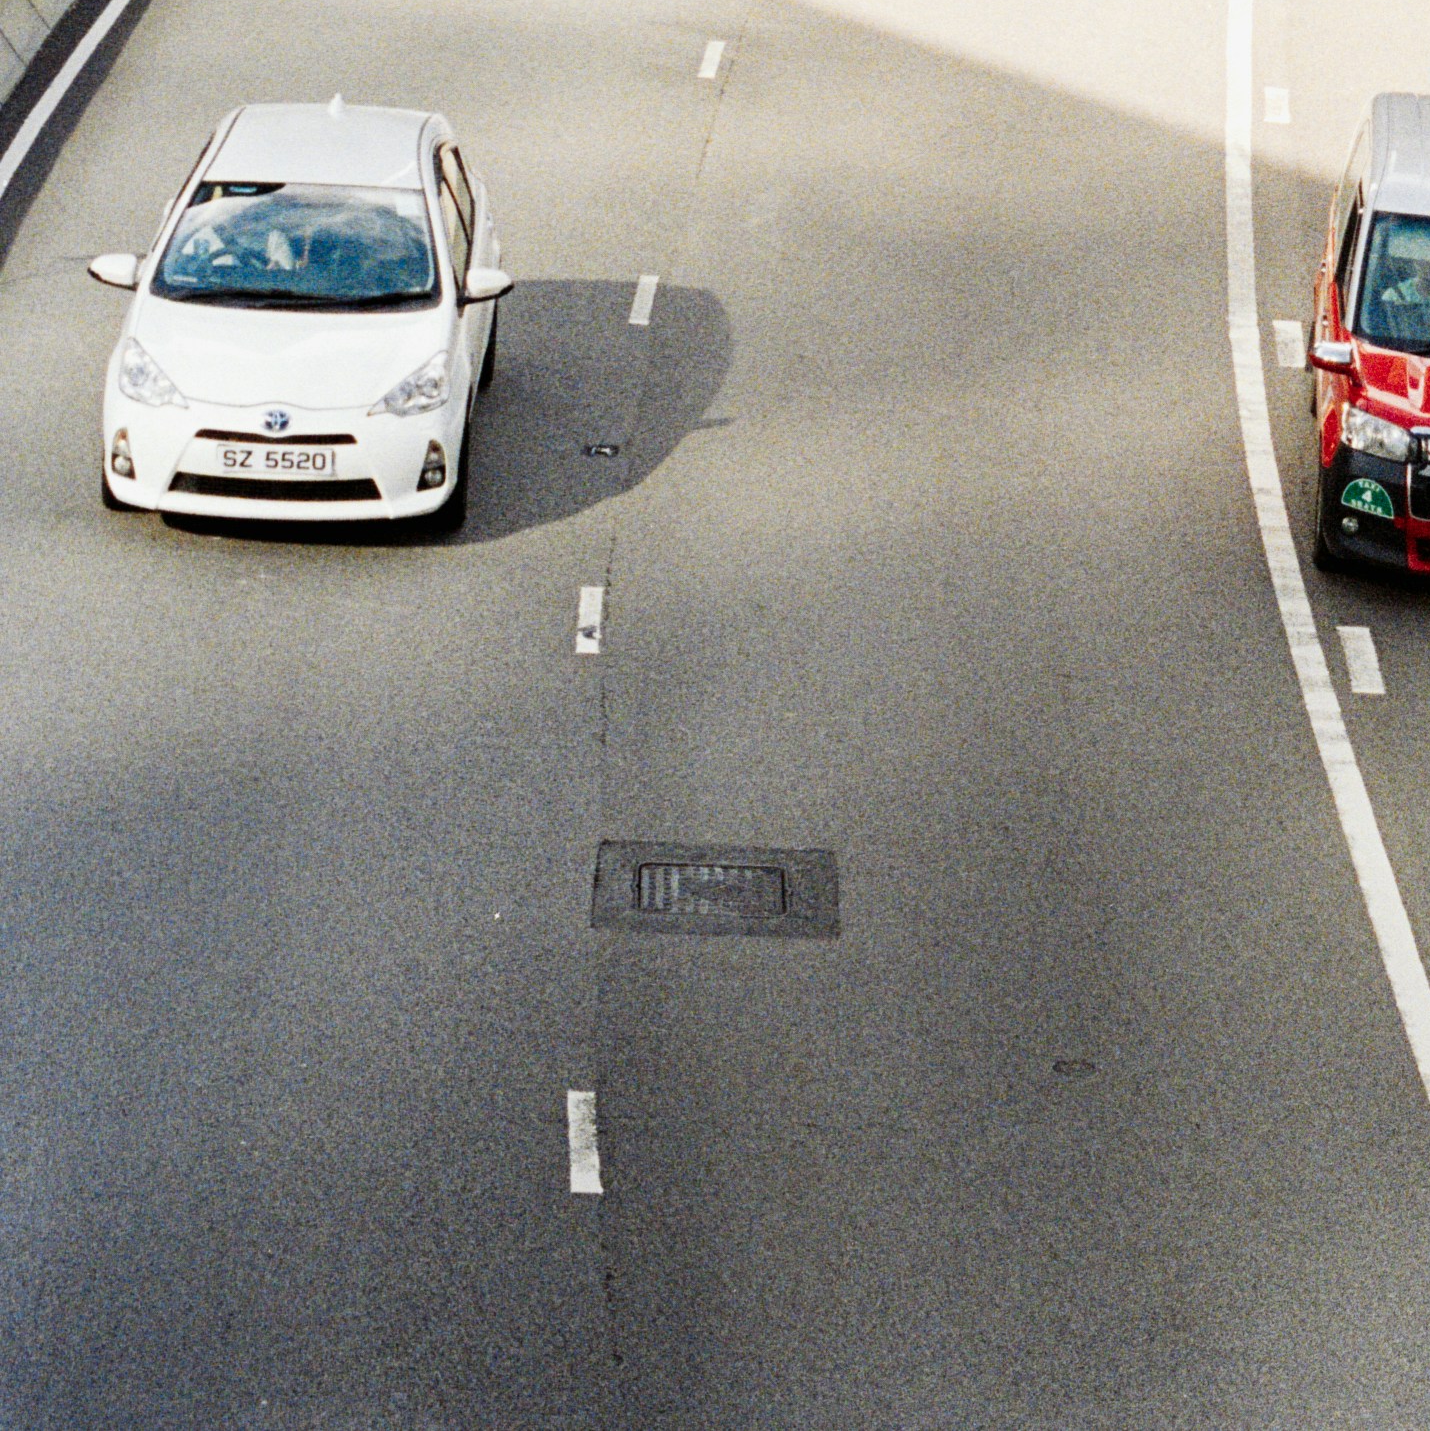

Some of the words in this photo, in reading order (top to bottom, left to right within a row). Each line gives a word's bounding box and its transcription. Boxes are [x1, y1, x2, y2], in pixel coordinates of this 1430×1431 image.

[223, 449, 254, 469] SZ
[265, 451, 328, 472] 5520
[1358, 480, 1380, 493] TAXI
[1361, 490, 1372, 503] 4
